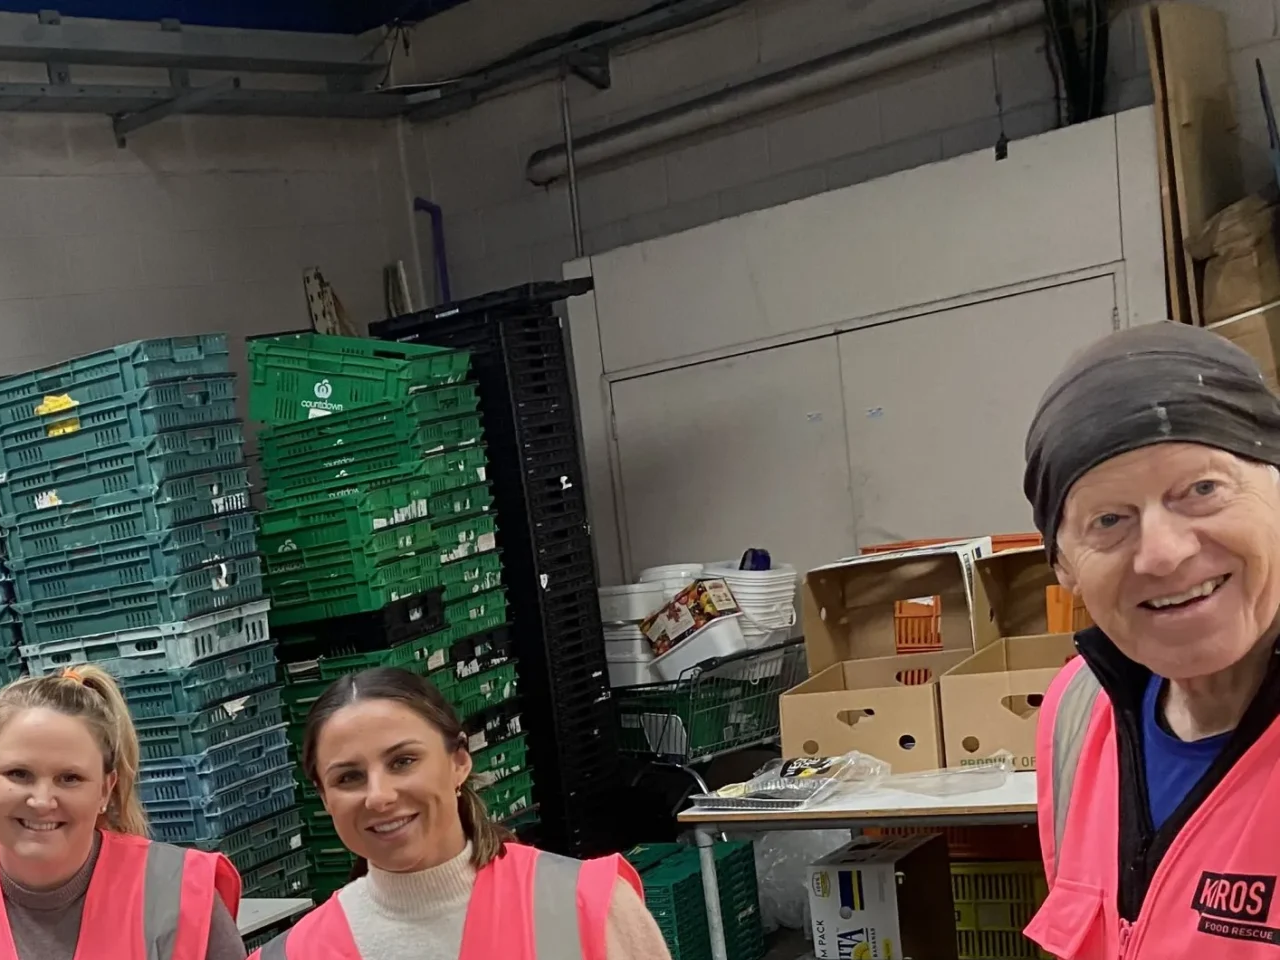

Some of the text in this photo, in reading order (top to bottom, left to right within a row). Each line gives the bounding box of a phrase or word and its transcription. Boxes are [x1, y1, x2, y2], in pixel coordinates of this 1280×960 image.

[301, 399, 343, 411] countdown
[816, 920, 826, 946] PACK
[1205, 922, 1273, 939] FOOD RESCUE
